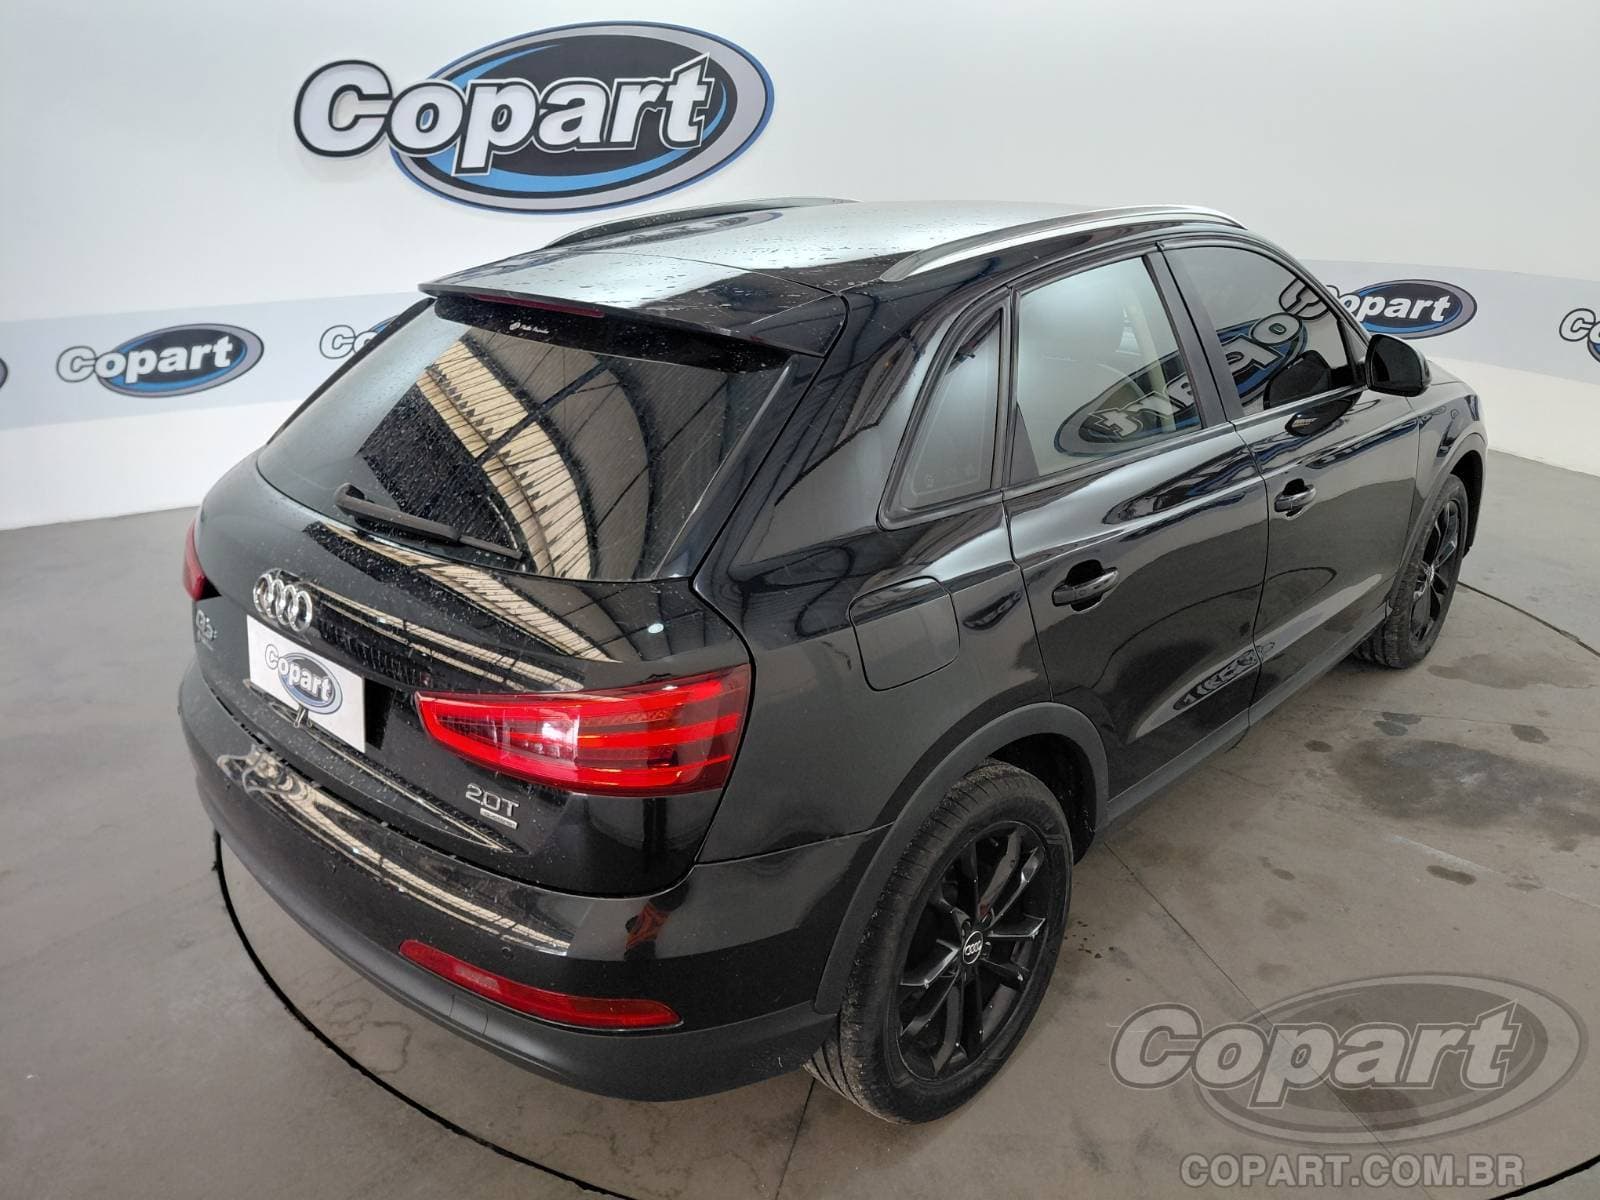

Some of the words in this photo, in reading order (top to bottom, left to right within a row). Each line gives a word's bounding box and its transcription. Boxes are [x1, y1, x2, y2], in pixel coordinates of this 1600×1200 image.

[294, 52, 715, 177] Copart
[1326, 284, 1452, 323] opart
[56, 335, 233, 384] Copart
[265, 644, 334, 702] Copart
